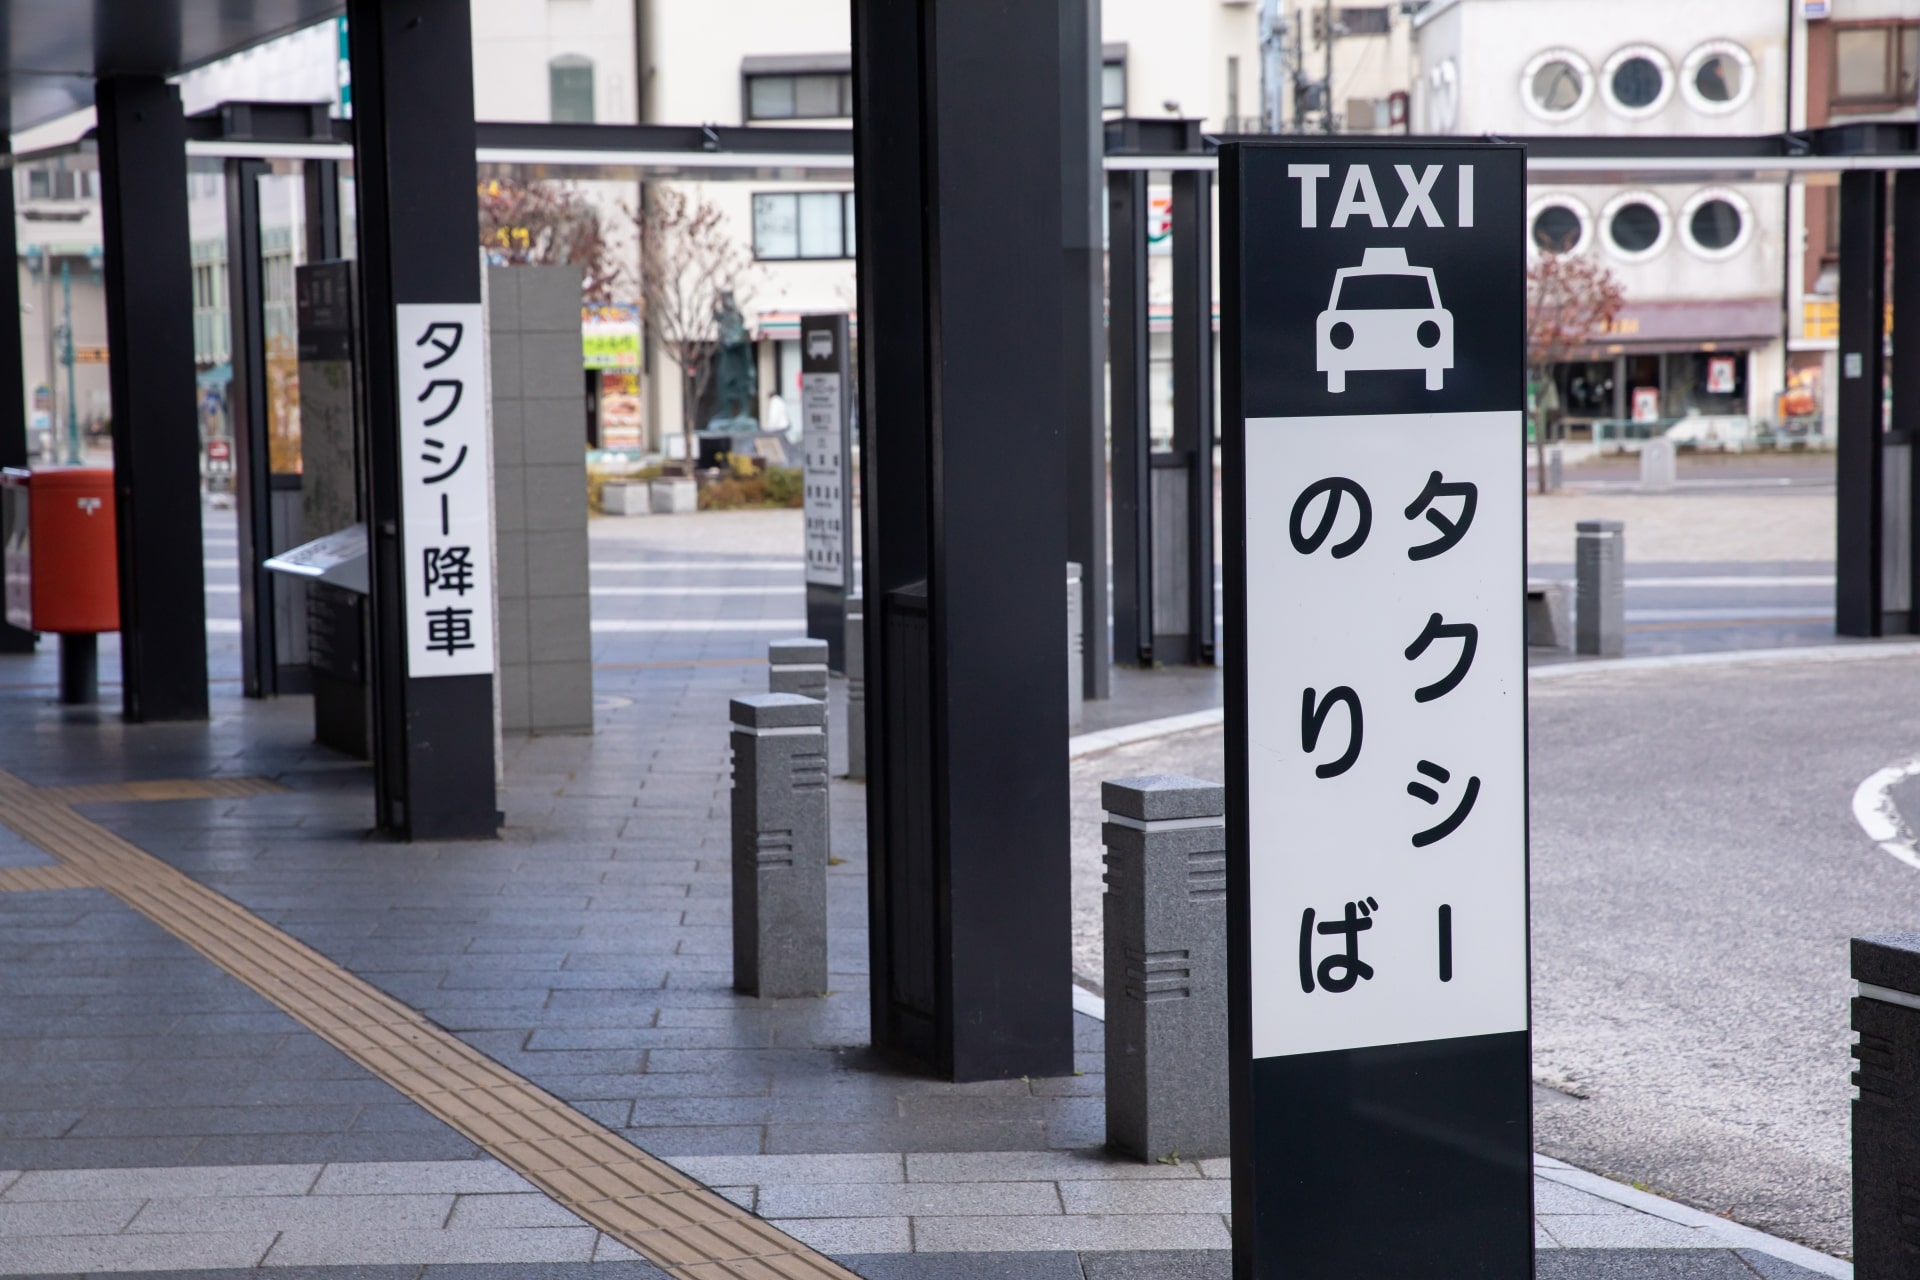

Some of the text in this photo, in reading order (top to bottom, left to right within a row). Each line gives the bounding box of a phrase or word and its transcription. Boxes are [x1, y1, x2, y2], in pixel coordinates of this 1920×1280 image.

[1287, 163, 1475, 229] TAXI
[416, 322, 475, 657] タクシー降車
[1288, 476, 1379, 994] のりば
[1404, 470, 1481, 983] タクシー
